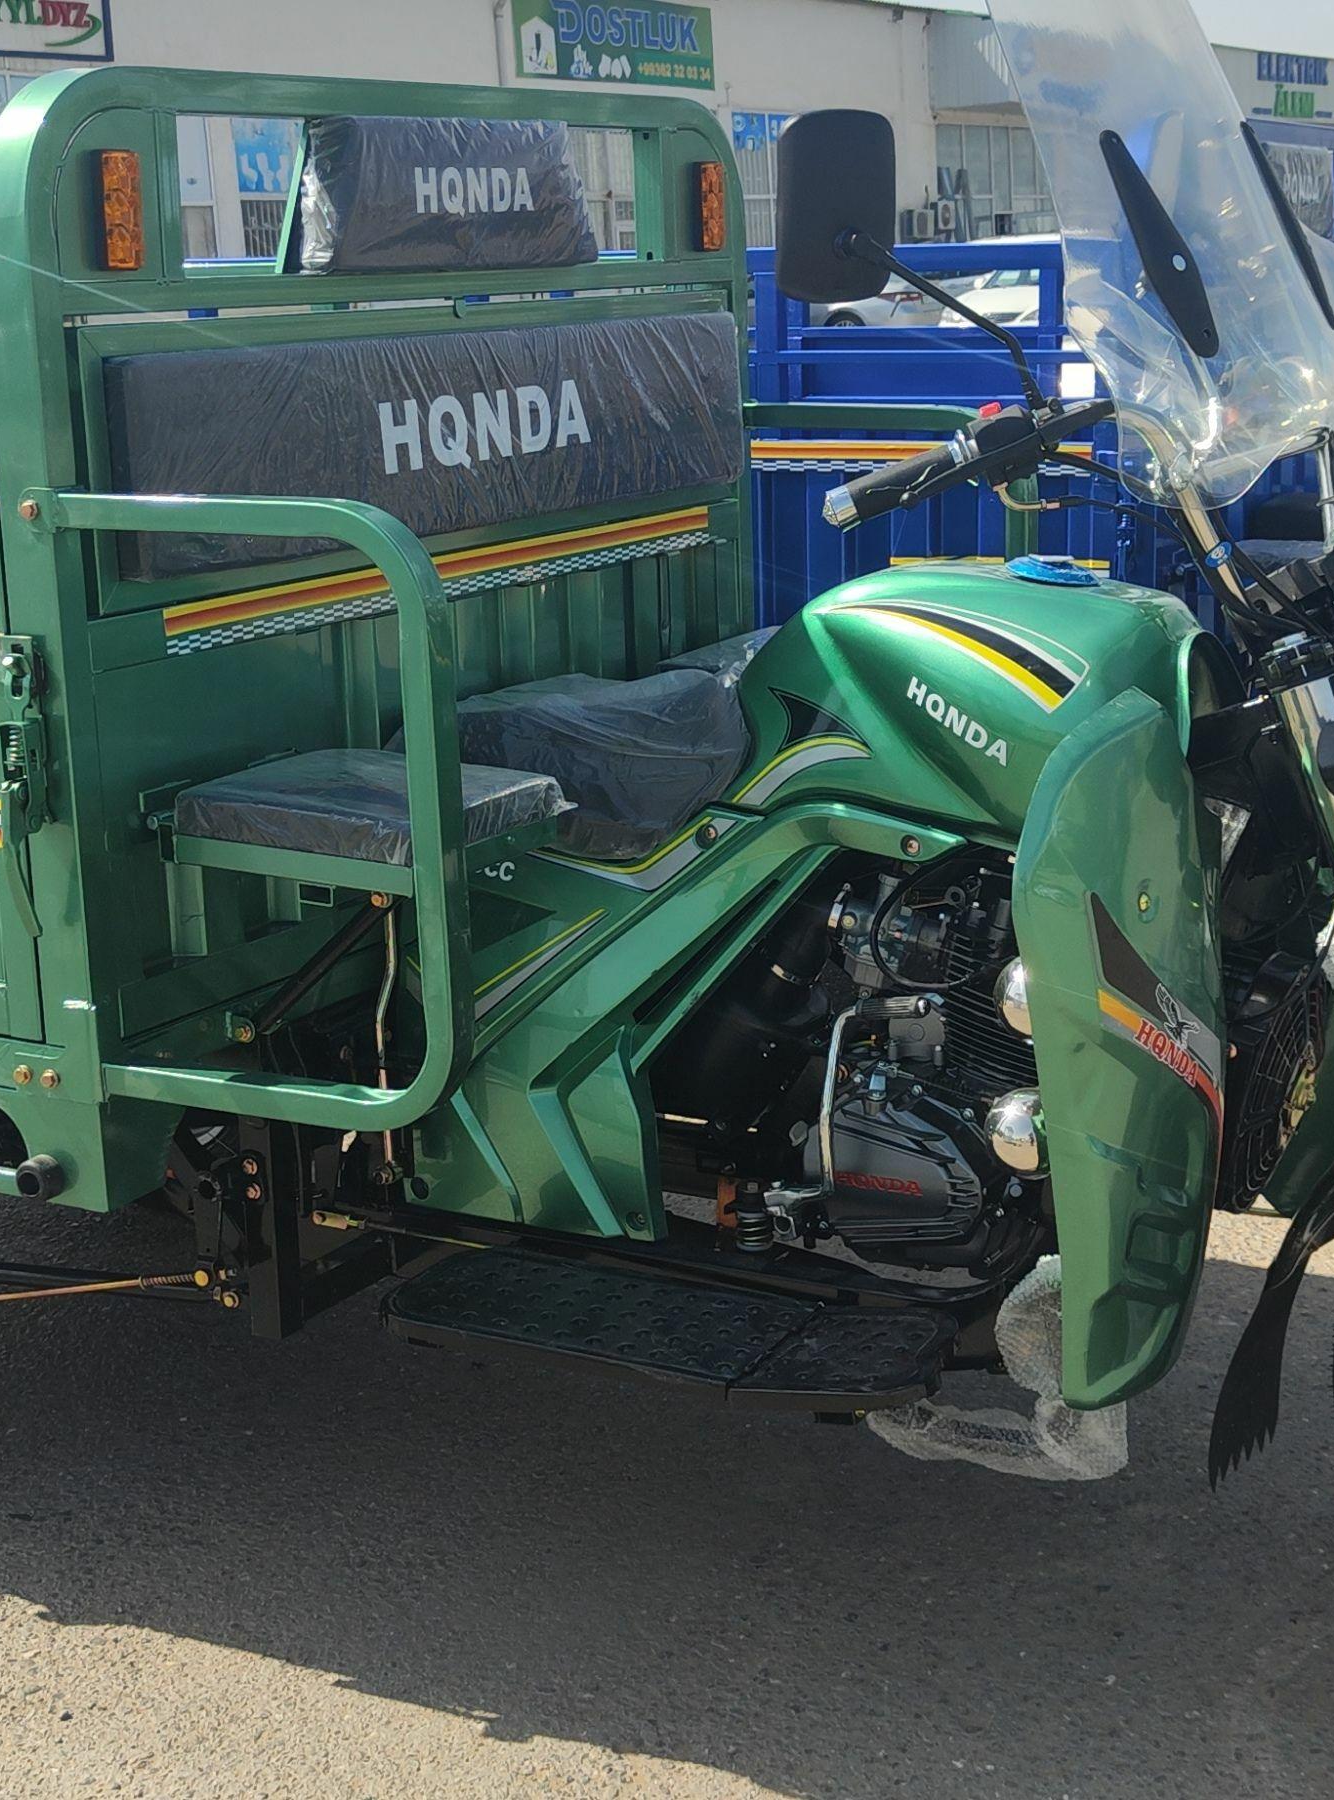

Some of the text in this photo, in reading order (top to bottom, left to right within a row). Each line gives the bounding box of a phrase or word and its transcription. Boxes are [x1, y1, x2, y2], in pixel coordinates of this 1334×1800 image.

[552, 0, 700, 54] DOSTLUK
[414, 166, 535, 218] HQNDA
[378, 379, 591, 475] HQNDA
[907, 676, 1007, 767] HQNDA
